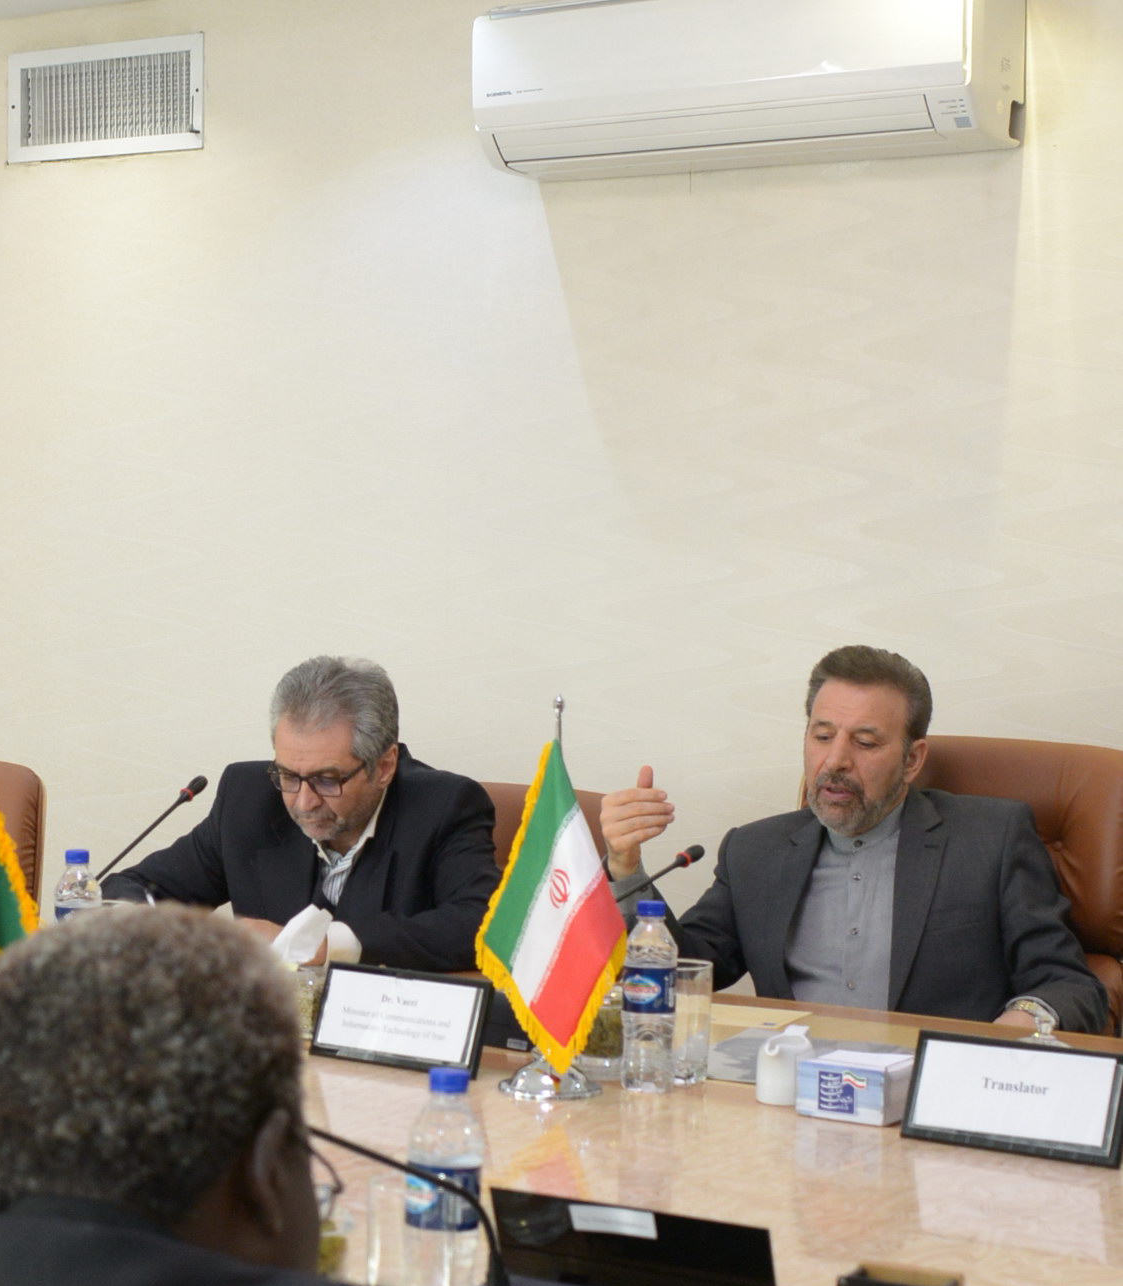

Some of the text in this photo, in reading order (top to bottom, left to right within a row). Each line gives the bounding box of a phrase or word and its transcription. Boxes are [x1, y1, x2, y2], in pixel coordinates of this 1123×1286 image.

[381, 994, 394, 1004] Dr.
[438, 1020, 452, 1028] and
[982, 1077, 1049, 1096] Translator
